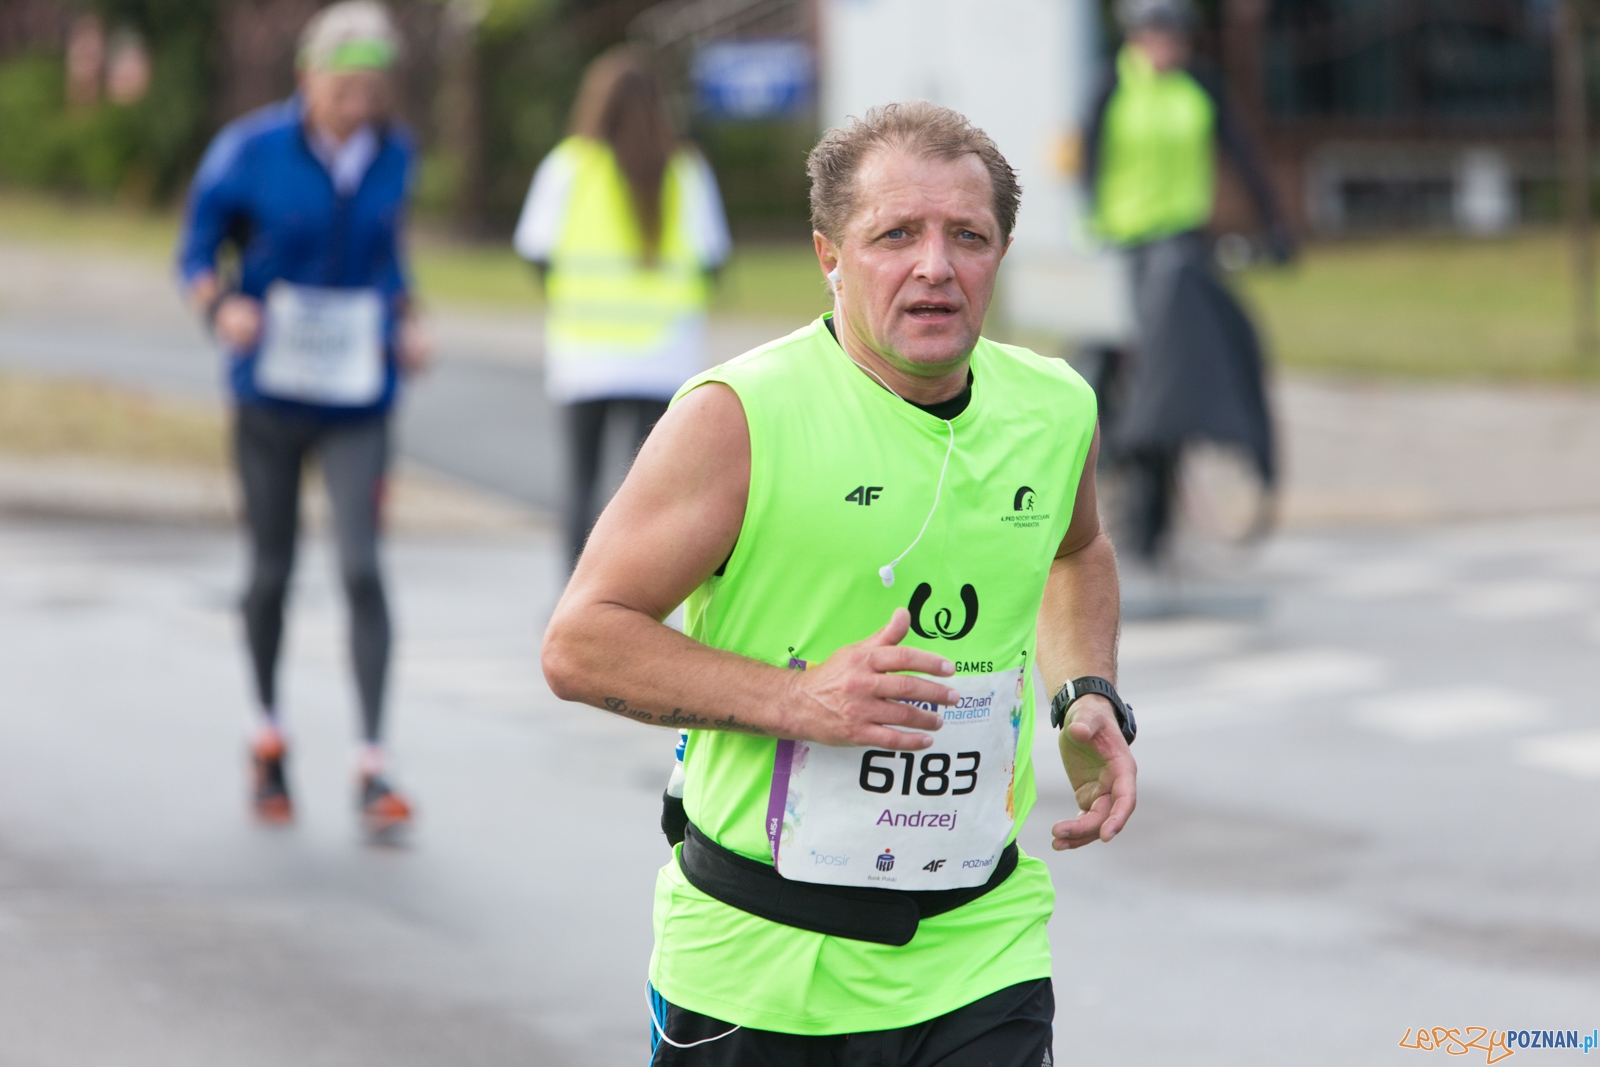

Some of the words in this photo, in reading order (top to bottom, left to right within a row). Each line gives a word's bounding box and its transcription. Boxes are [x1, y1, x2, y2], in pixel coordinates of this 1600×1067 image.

[844, 485, 884, 506] 4F
[955, 661, 993, 673] GAMES
[604, 697, 652, 720] Dum
[943, 707, 991, 720] maraton
[859, 749, 981, 797] 6183
[876, 809, 958, 832] Andrzej
[922, 859, 947, 872] 4F
